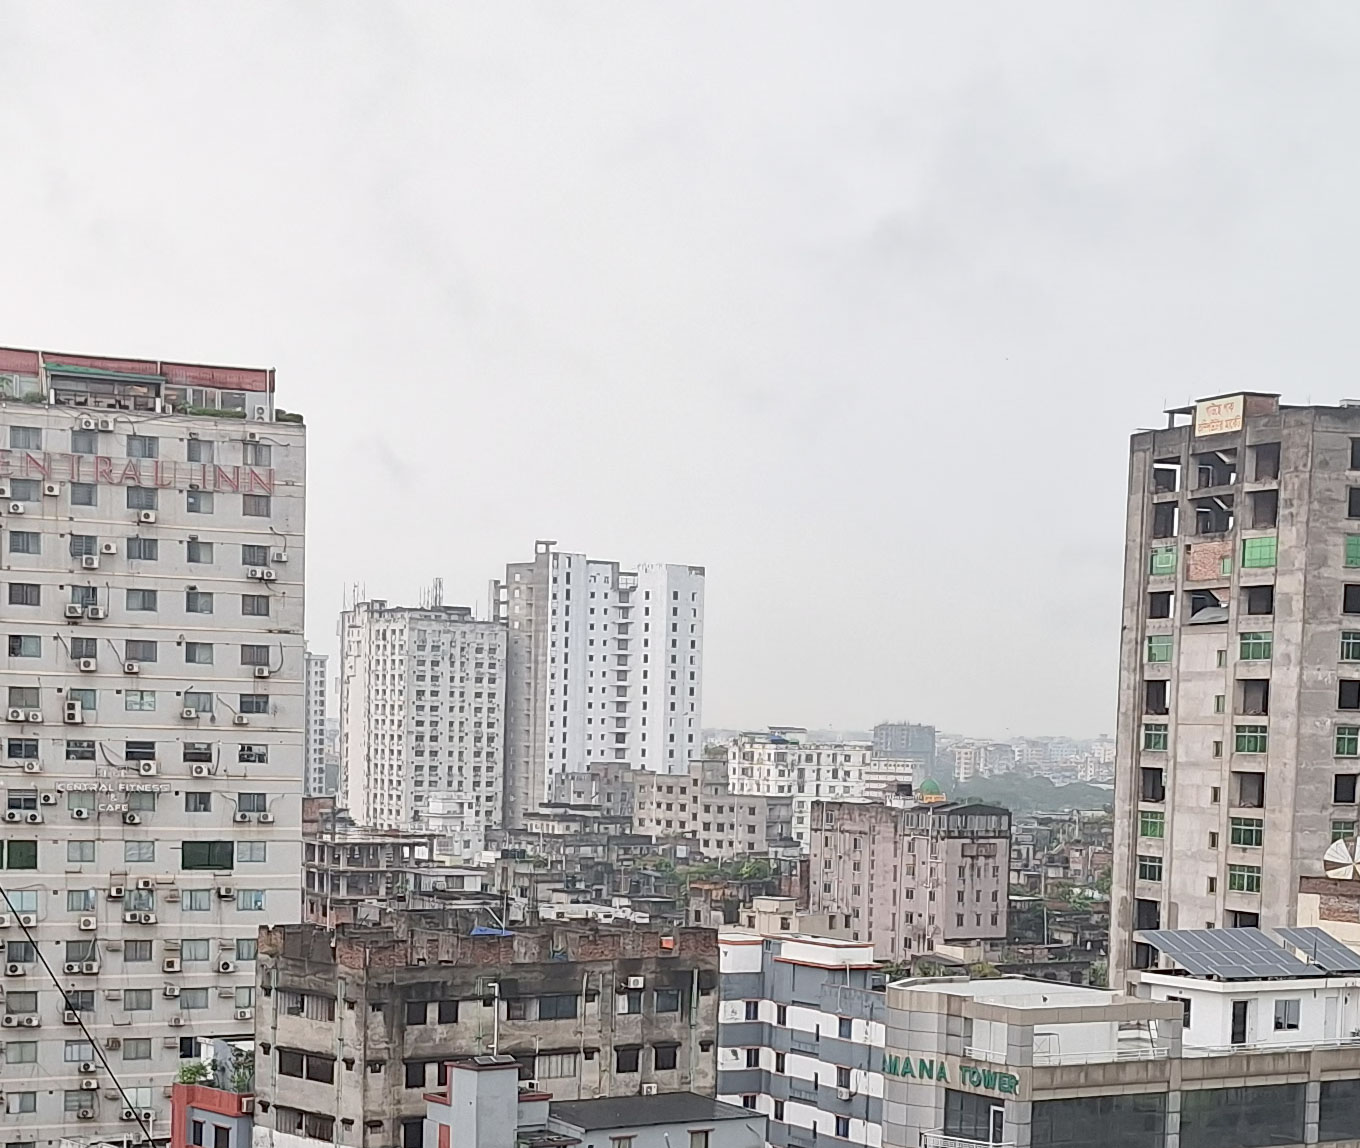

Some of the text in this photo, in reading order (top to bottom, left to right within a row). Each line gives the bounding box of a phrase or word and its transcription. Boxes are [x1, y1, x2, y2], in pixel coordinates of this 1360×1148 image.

[200, 462, 275, 495] INN
[882, 1053, 1019, 1096] AMANA TOWER
